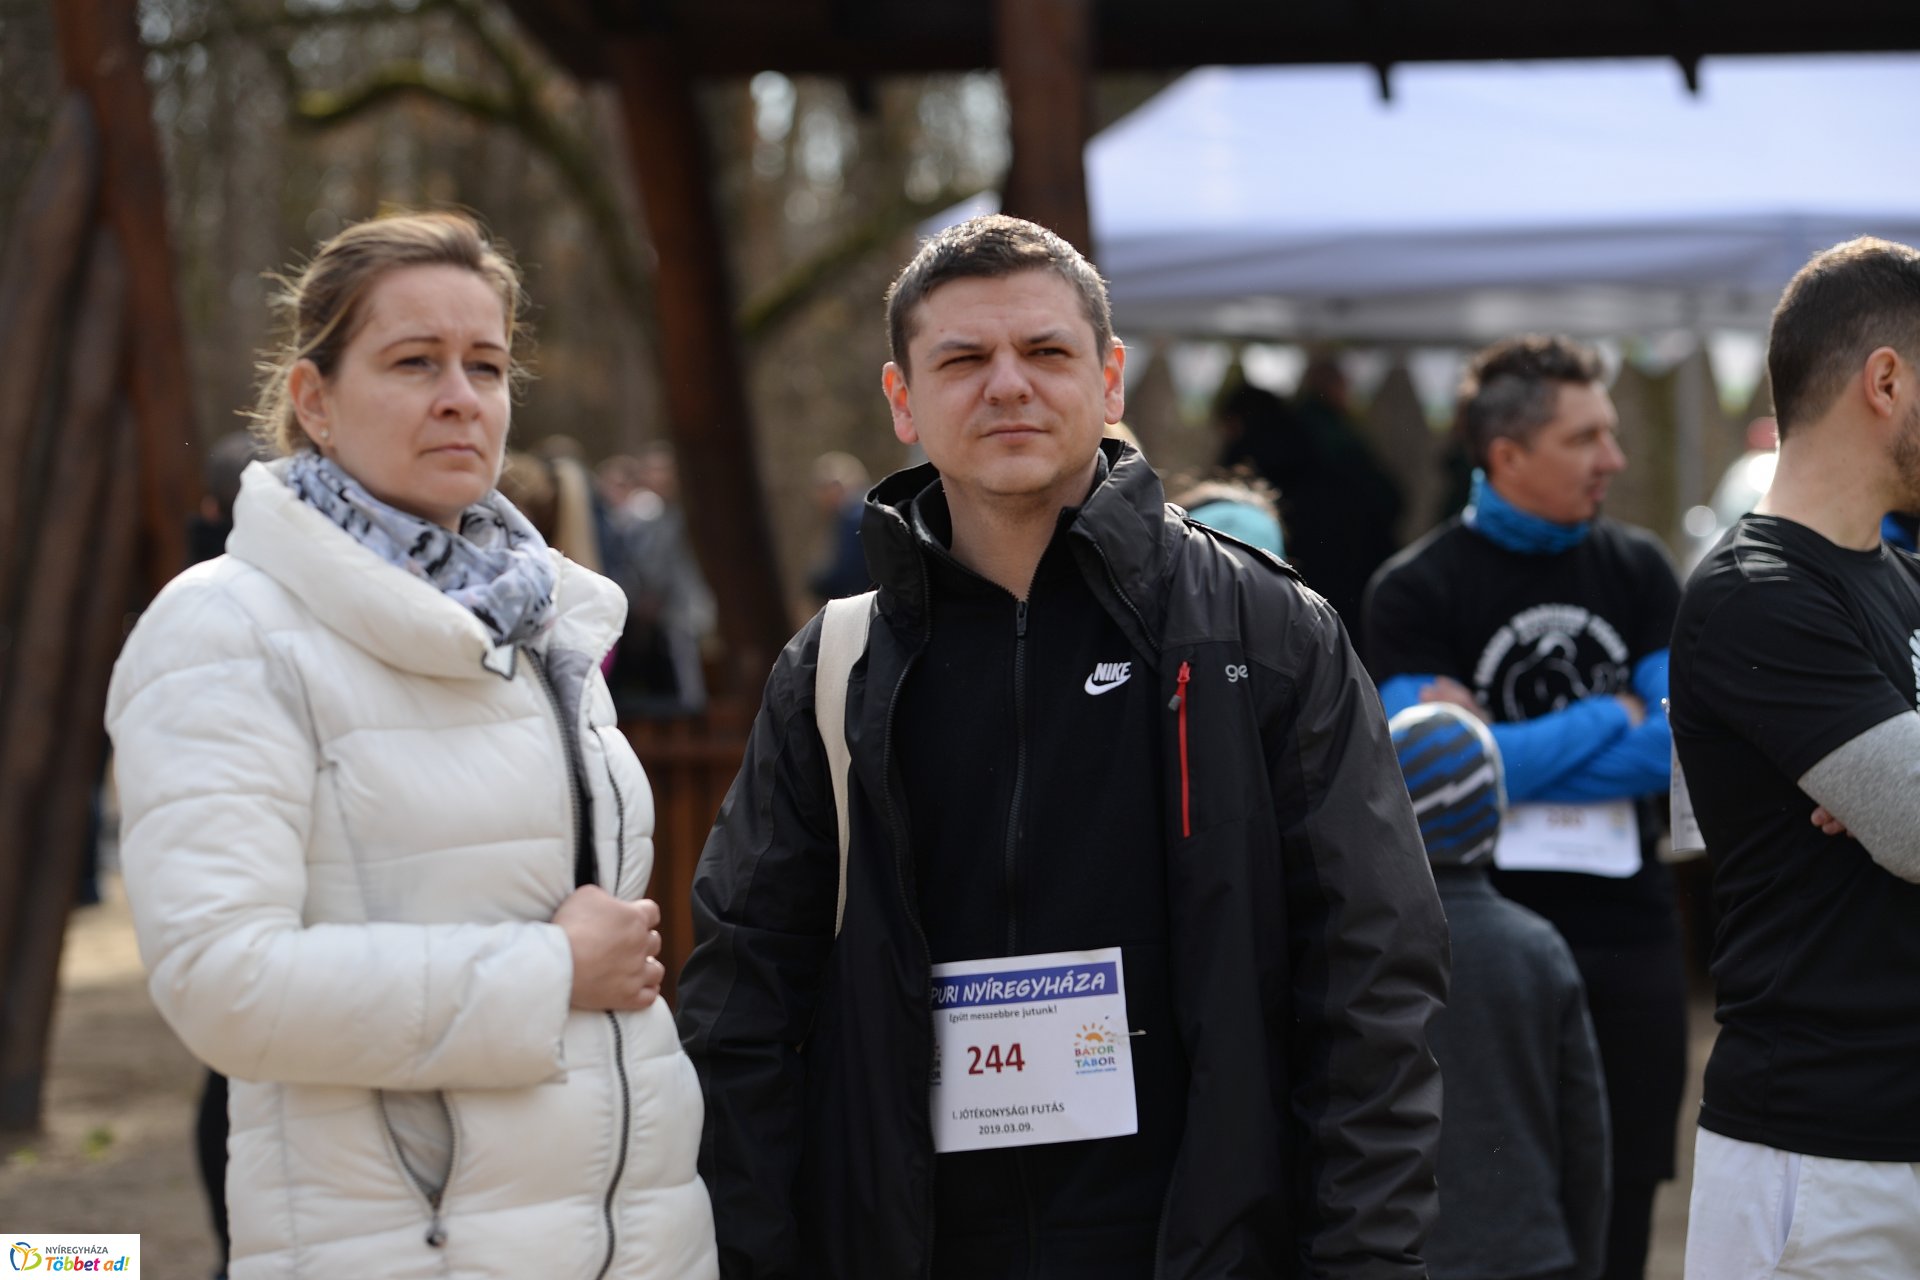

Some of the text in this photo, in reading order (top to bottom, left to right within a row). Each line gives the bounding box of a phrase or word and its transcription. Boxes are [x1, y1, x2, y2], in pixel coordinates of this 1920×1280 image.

[1094, 662, 1132, 681] NIKE
[962, 970, 1106, 1003] NYÍREGYHÁZA
[970, 1009, 1020, 1021] messzebbre
[1022, 1004, 1058, 1019] jutunk!
[967, 1042, 1026, 1076] 244
[1074, 1056, 1116, 1069] TÁBOR
[959, 1105, 1030, 1121] JÓTÉKONYSÁGI
[1031, 1102, 1065, 1115] FUTÁS
[979, 1122, 1035, 1136] 2019.03.09.
